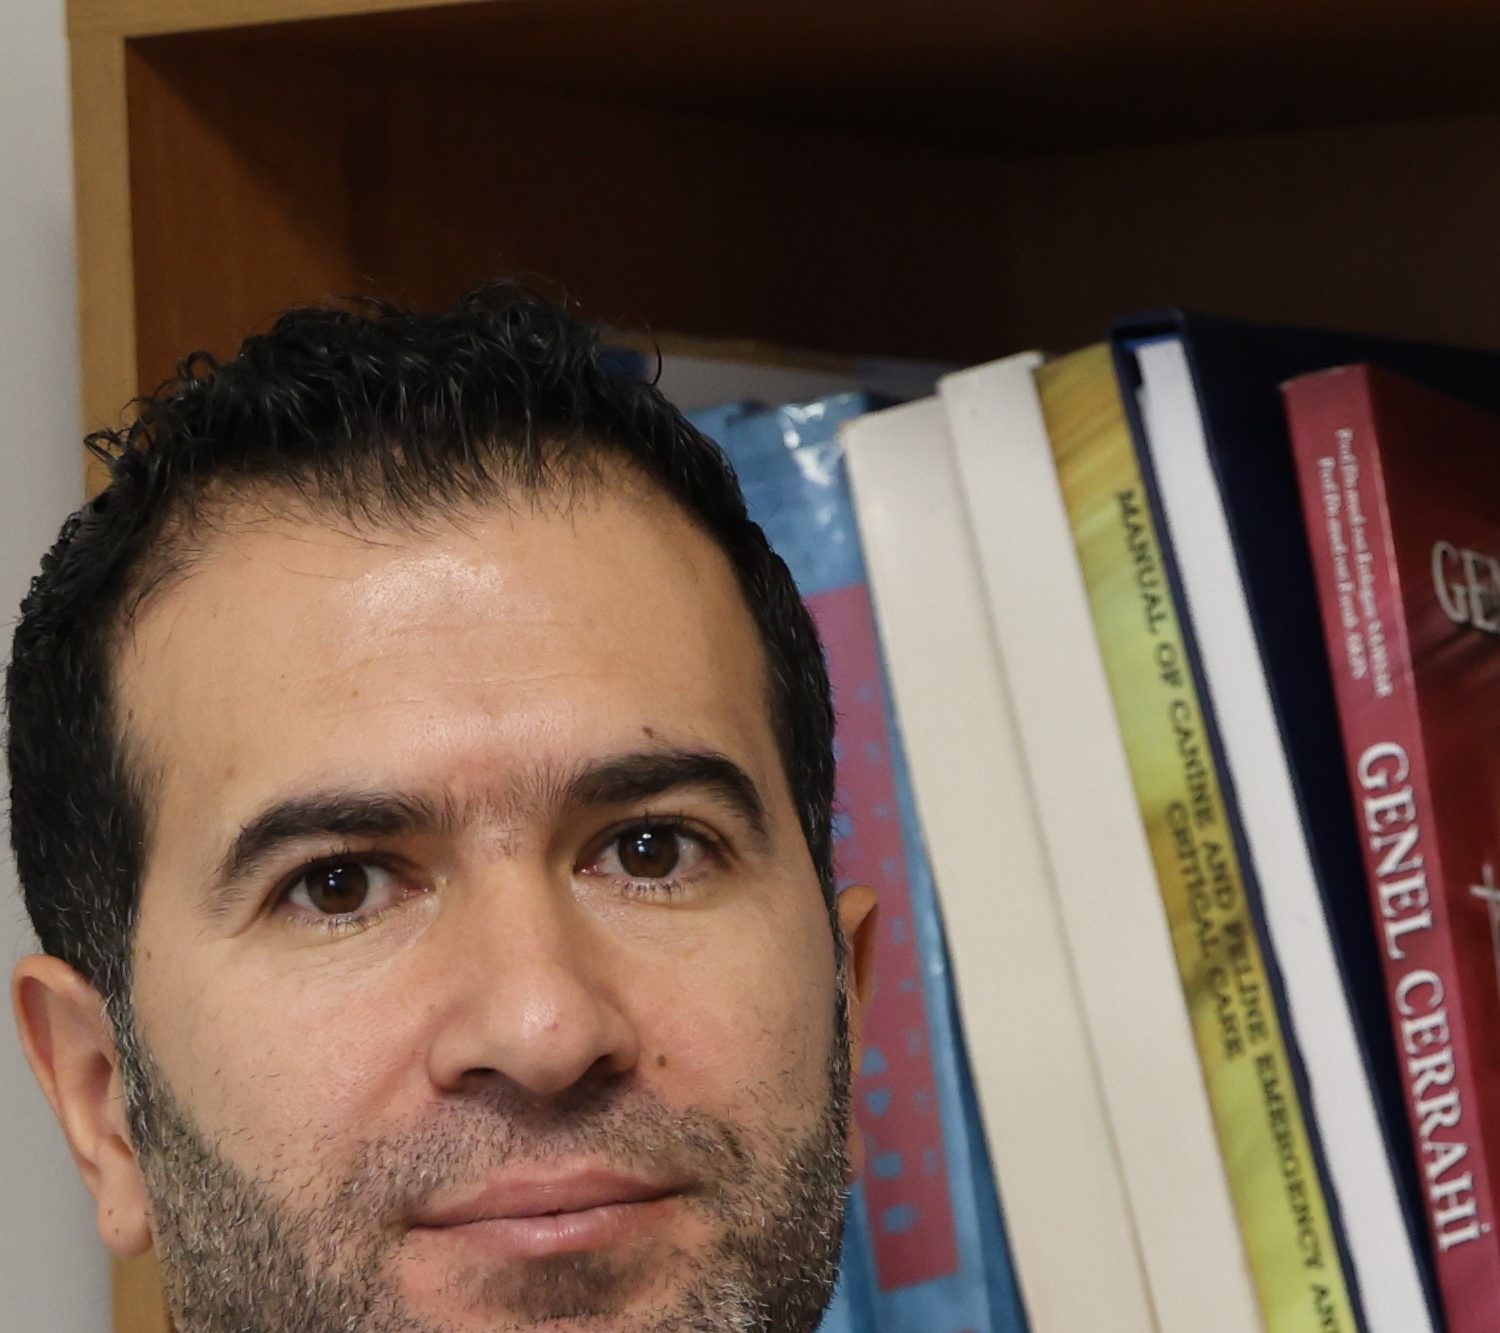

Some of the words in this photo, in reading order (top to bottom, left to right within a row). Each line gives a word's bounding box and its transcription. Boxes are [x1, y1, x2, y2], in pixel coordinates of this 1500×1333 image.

[1116, 488, 1162, 636] MANUAL
[1155, 642, 1184, 690] OF
[1203, 839, 1238, 913] AND
[1356, 740, 1434, 960] GENEL
